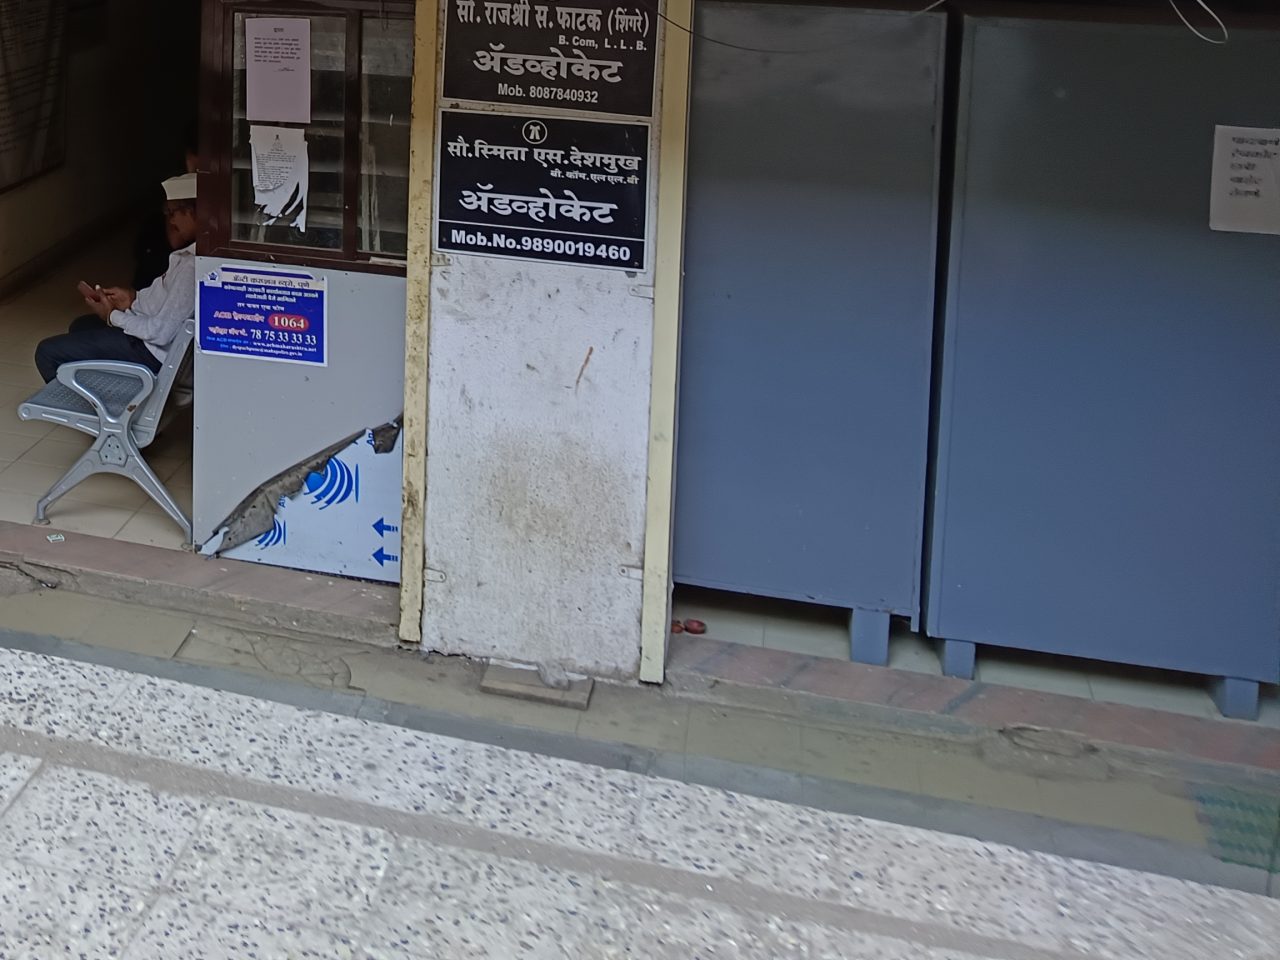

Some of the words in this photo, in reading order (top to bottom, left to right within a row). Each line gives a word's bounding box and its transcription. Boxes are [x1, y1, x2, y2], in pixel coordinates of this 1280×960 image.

[497, 83, 526, 98] Mob.
[529, 85, 599, 103] 8087840932
[273, 316, 305, 329] 1064
[250, 329, 262, 340] 78
[265, 330, 275, 341] 75
[278, 331, 289, 342] 33
[291, 333, 302, 344] 33
[305, 335, 317, 345] 33
